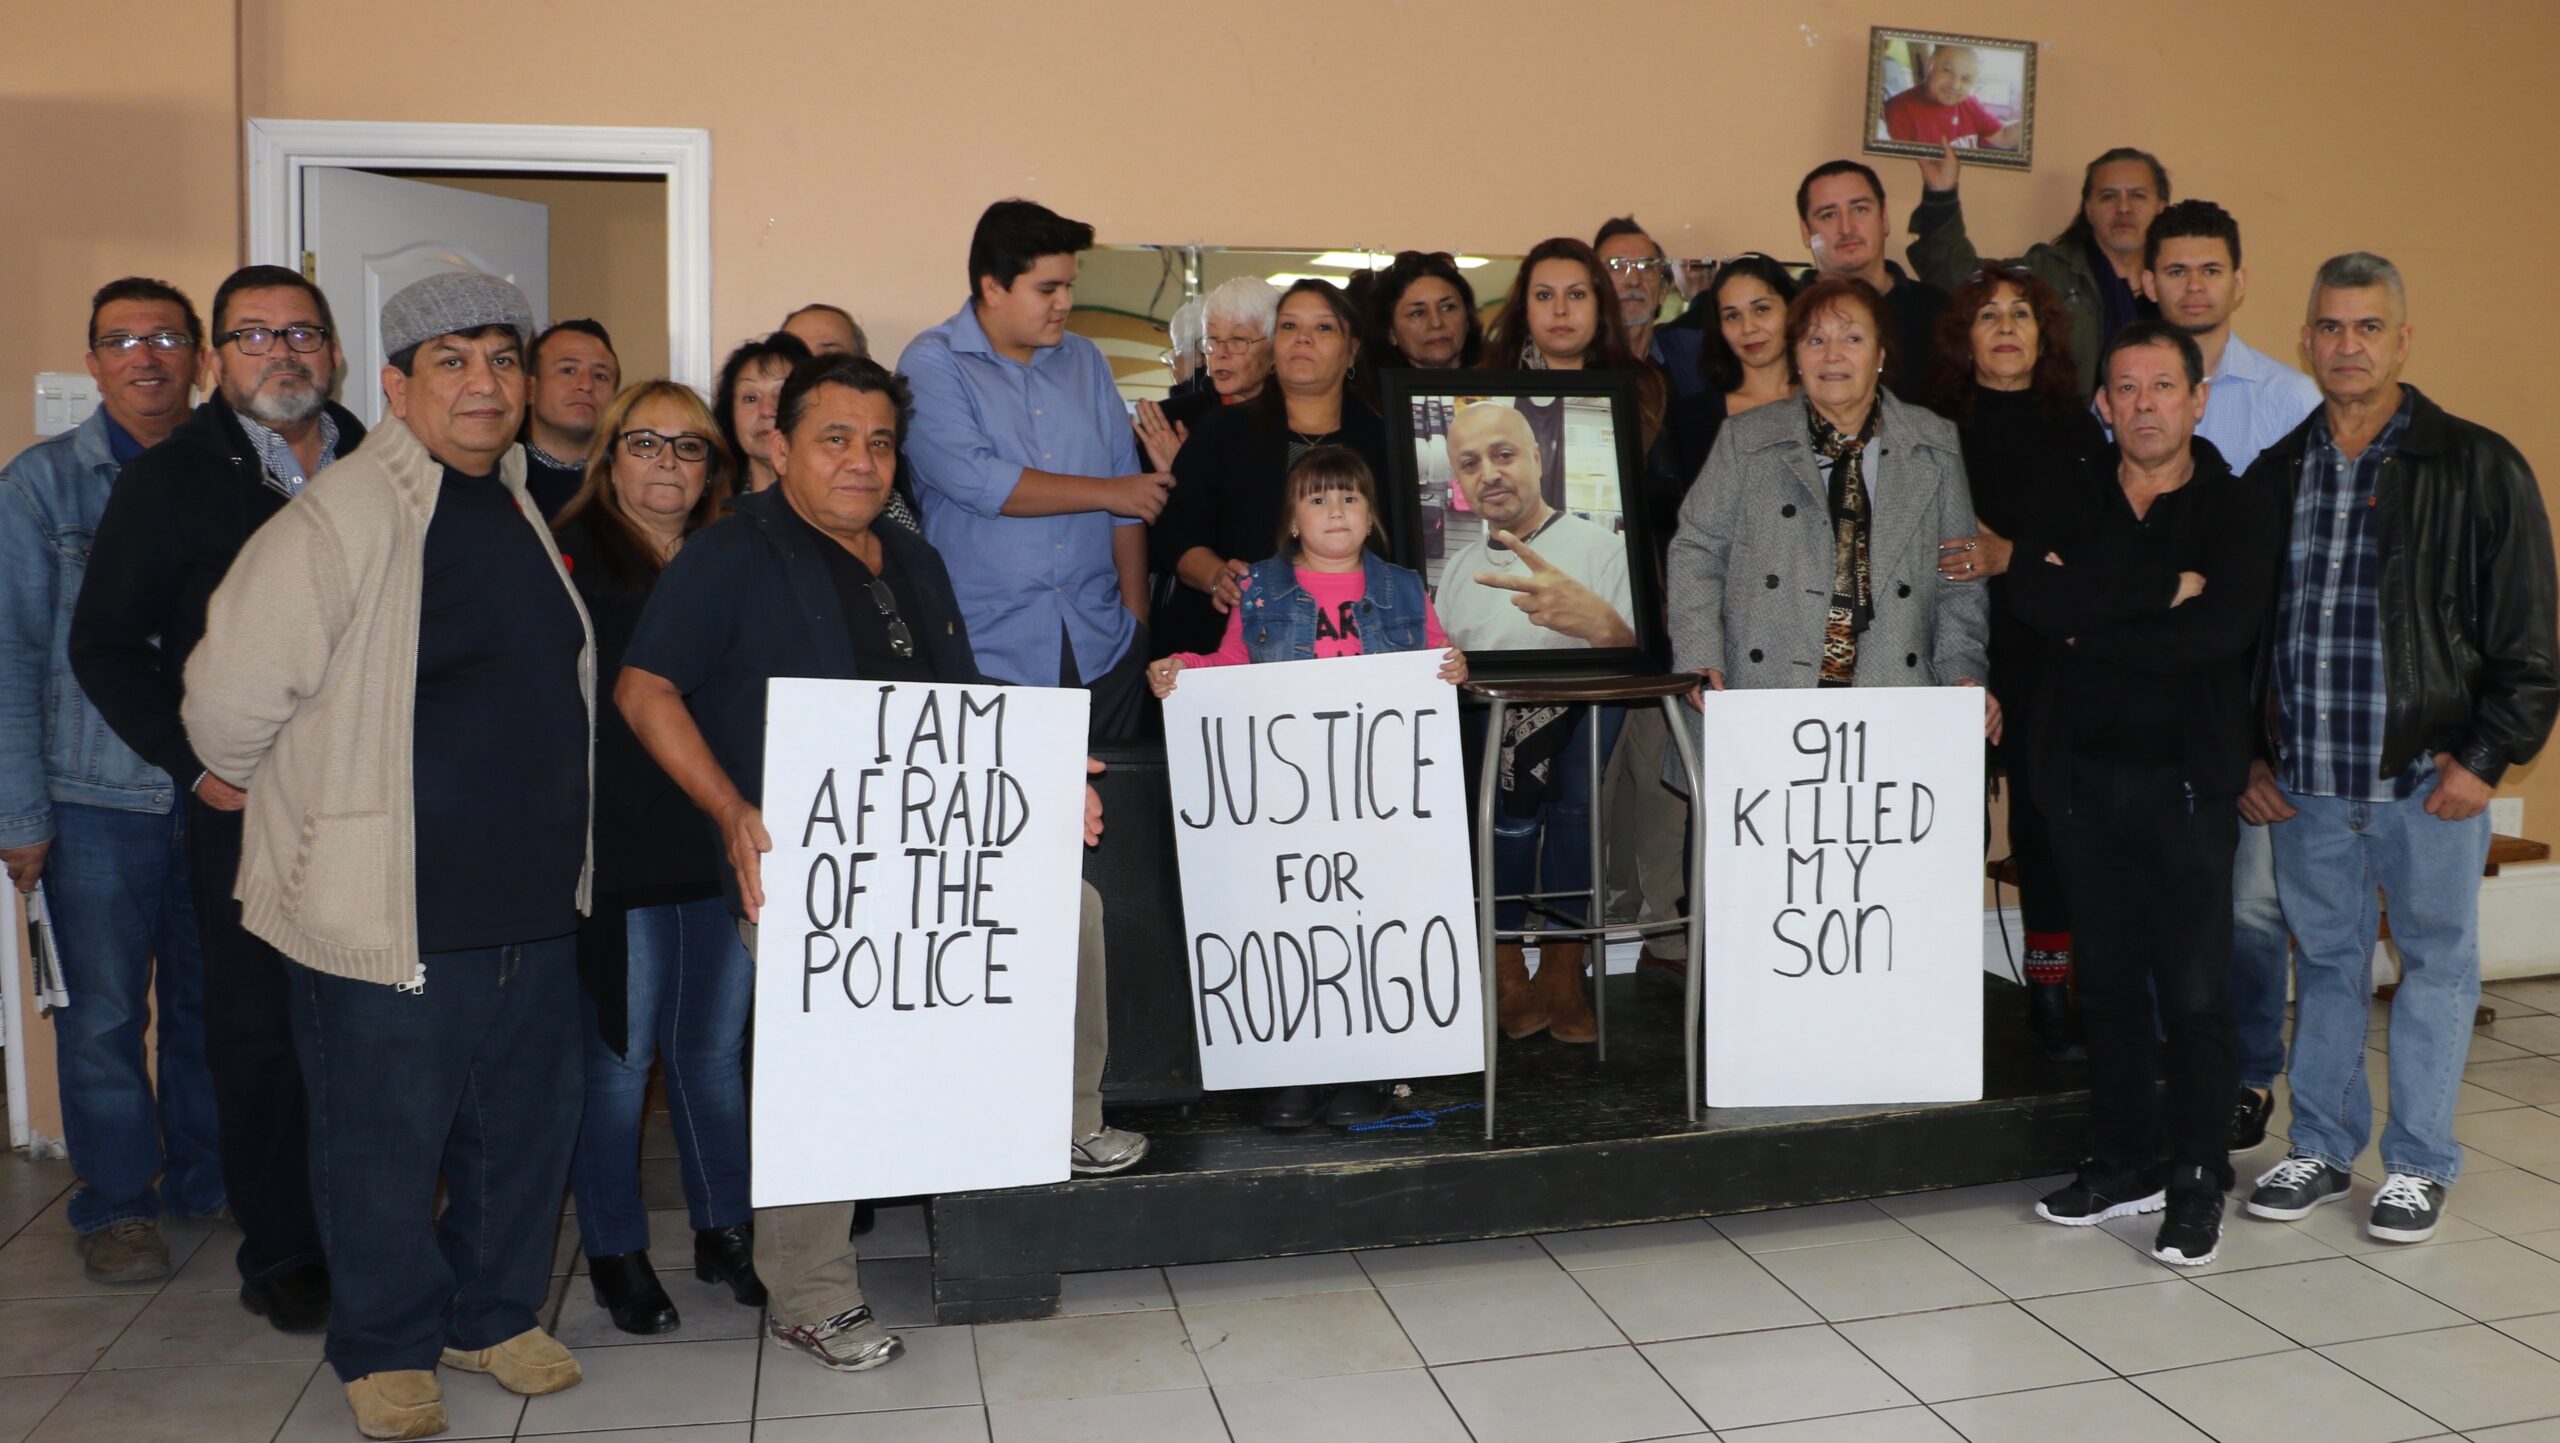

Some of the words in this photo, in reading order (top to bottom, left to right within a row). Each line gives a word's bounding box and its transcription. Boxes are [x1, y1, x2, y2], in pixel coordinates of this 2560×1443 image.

[874, 684, 897, 765] I
[905, 689, 1007, 768] AM
[1789, 718, 1867, 787] 911
[801, 765, 1030, 848] AFRAID
[1733, 781, 1936, 847] KILLED
[805, 852, 878, 931] OF
[903, 847, 1004, 930] THE
[1276, 851, 1364, 904] FOR
[1786, 844, 1873, 905] MY
[802, 927, 1018, 1013] POLICE
